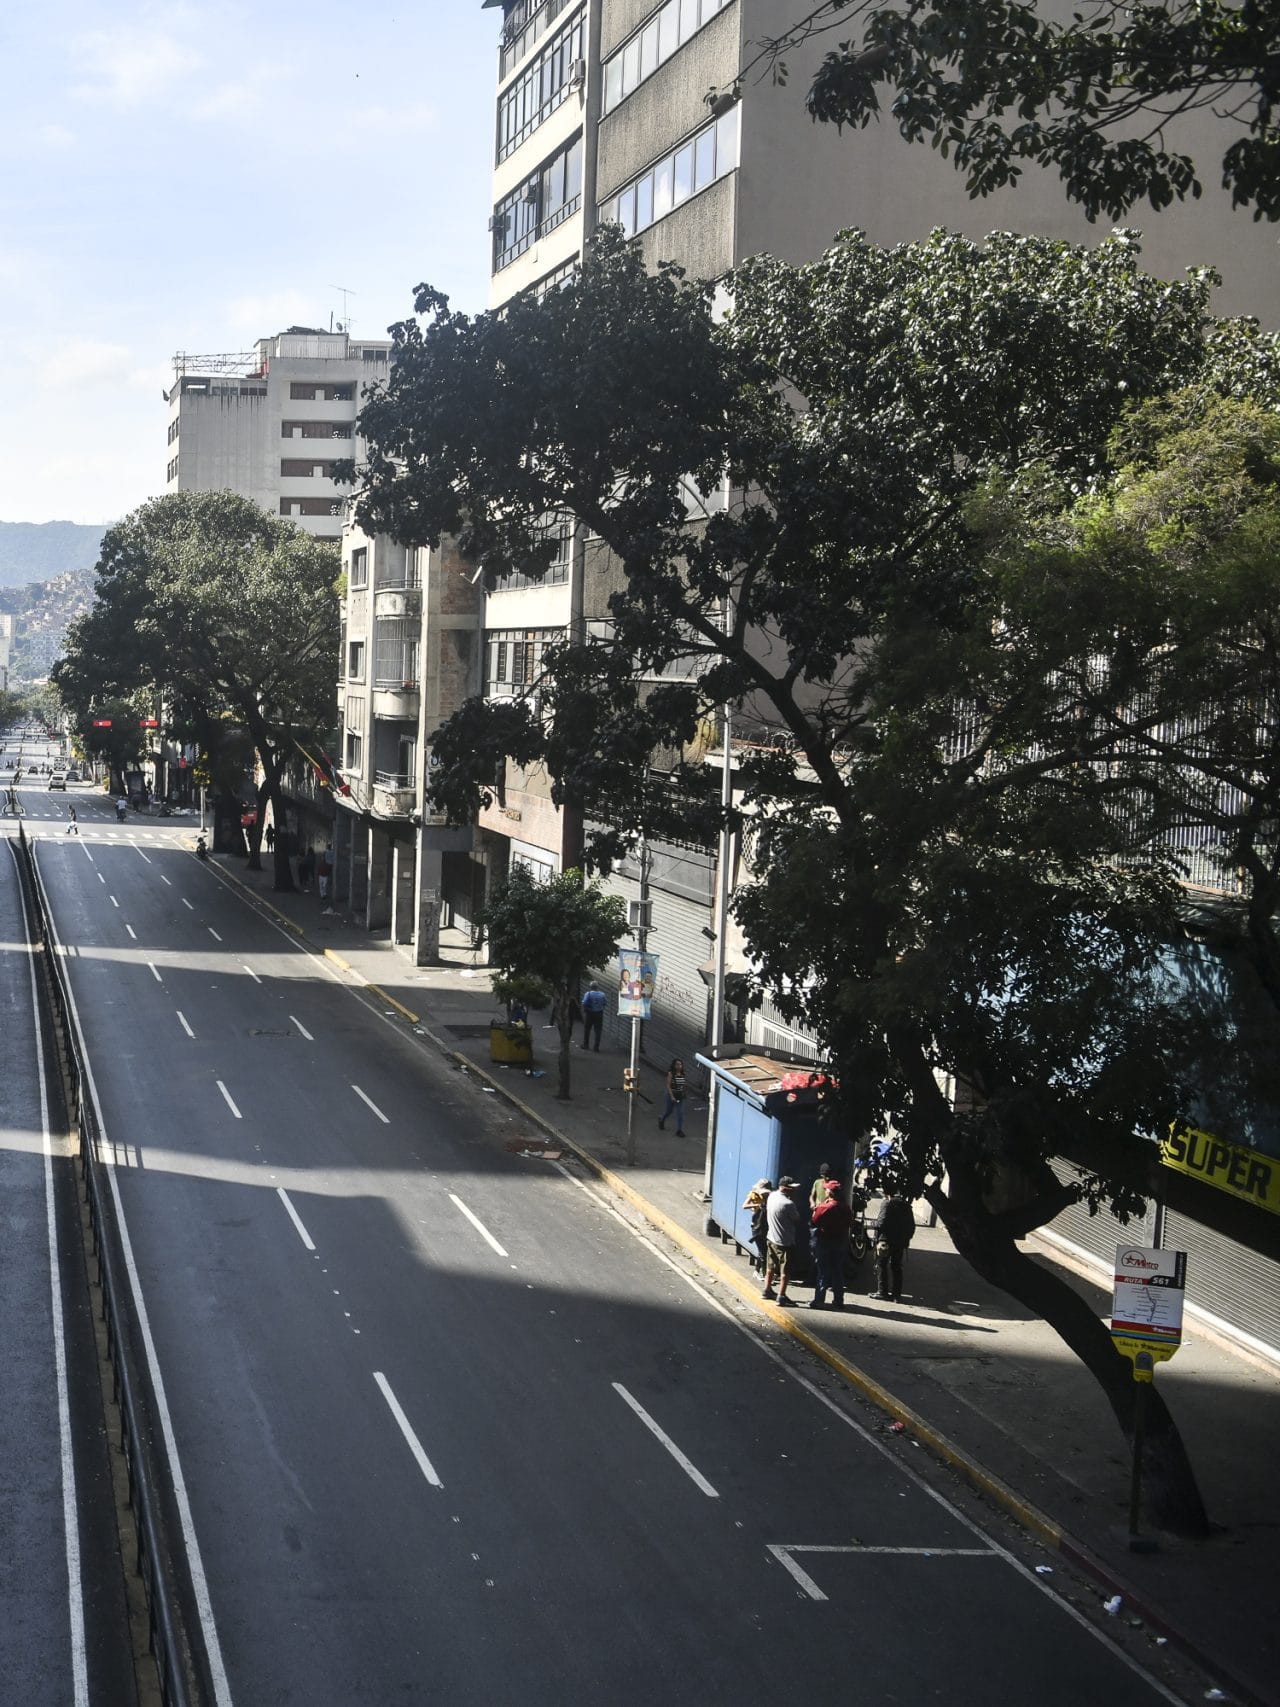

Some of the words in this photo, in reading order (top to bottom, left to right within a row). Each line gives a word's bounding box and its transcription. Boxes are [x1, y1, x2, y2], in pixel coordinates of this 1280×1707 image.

[1167, 1126, 1272, 1200] SUPER
[1134, 1258, 1159, 1270] Metro
[1123, 1276, 1143, 1286] RUTA
